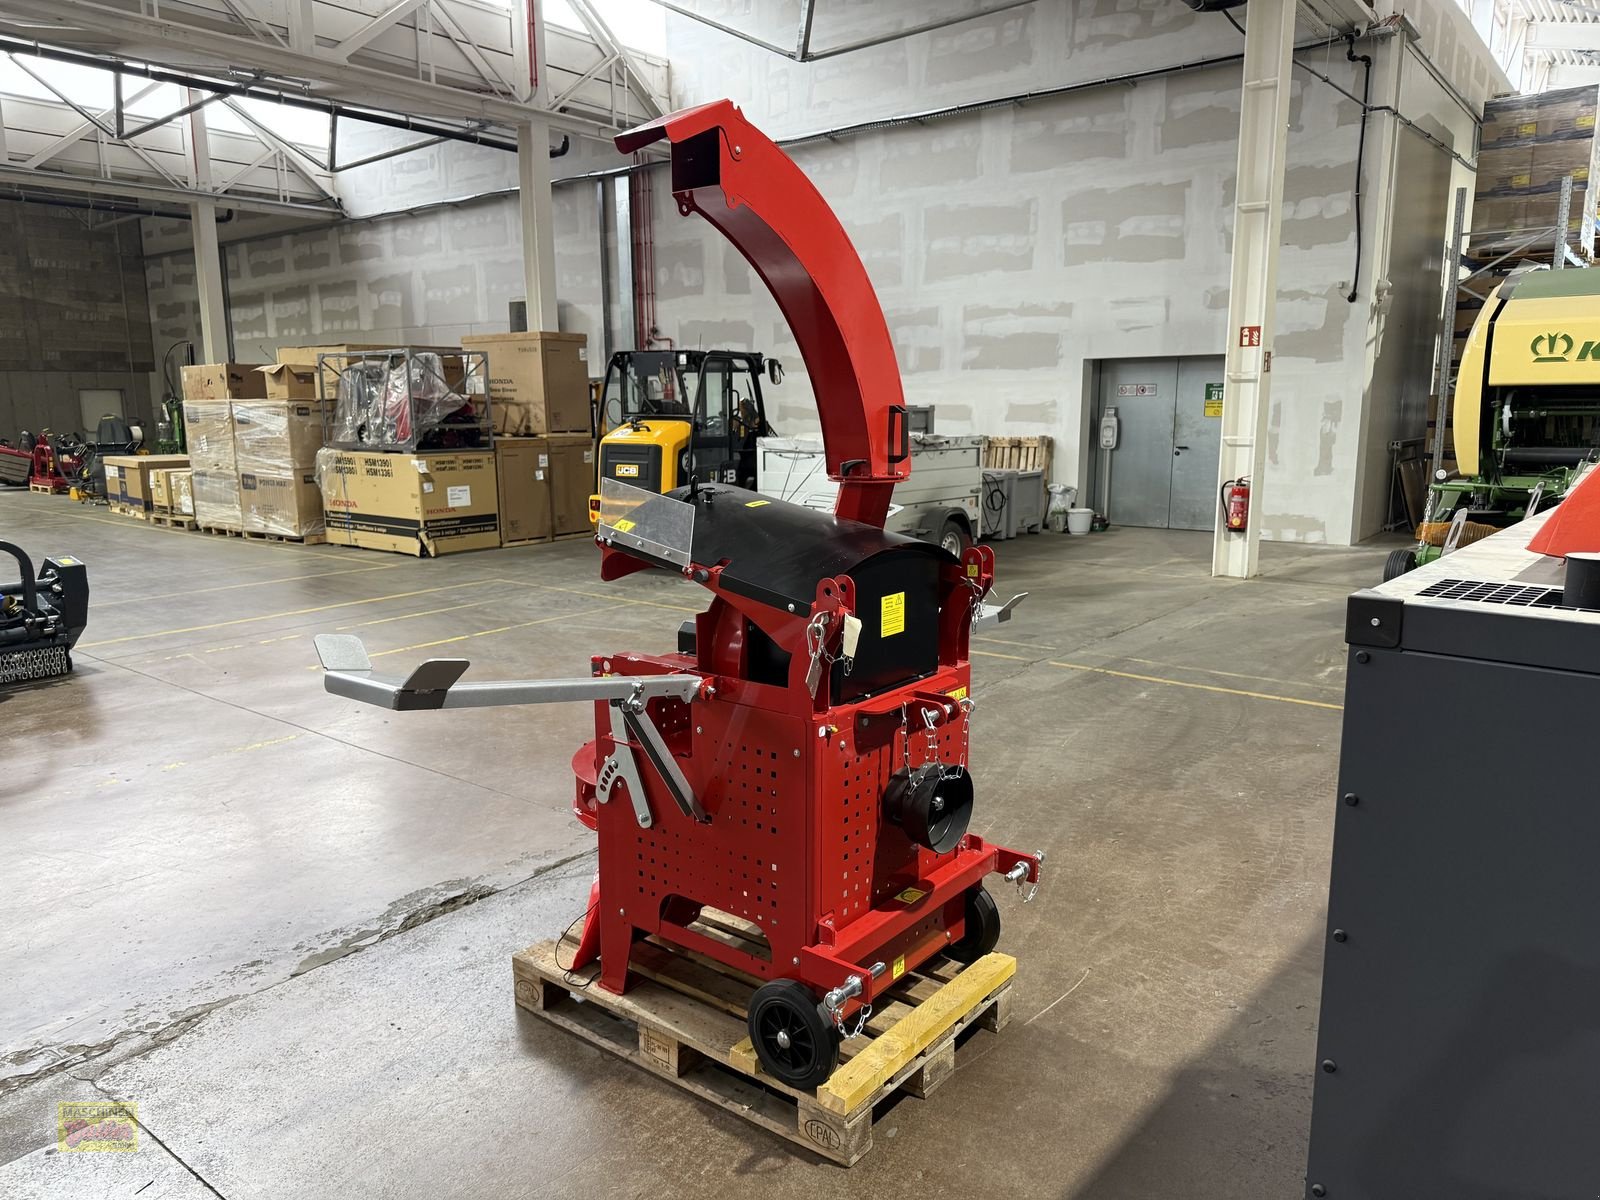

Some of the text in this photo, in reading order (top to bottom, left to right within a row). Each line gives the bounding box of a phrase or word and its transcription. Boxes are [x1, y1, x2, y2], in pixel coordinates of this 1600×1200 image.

[365, 457, 393, 468] HSM1390i
[366, 467, 394, 478] HSM1336i
[617, 466, 637, 475] JCB
[329, 499, 358, 509] HONDA
[426, 507, 456, 516] HONDA
[810, 1122, 839, 1150] EPAL
